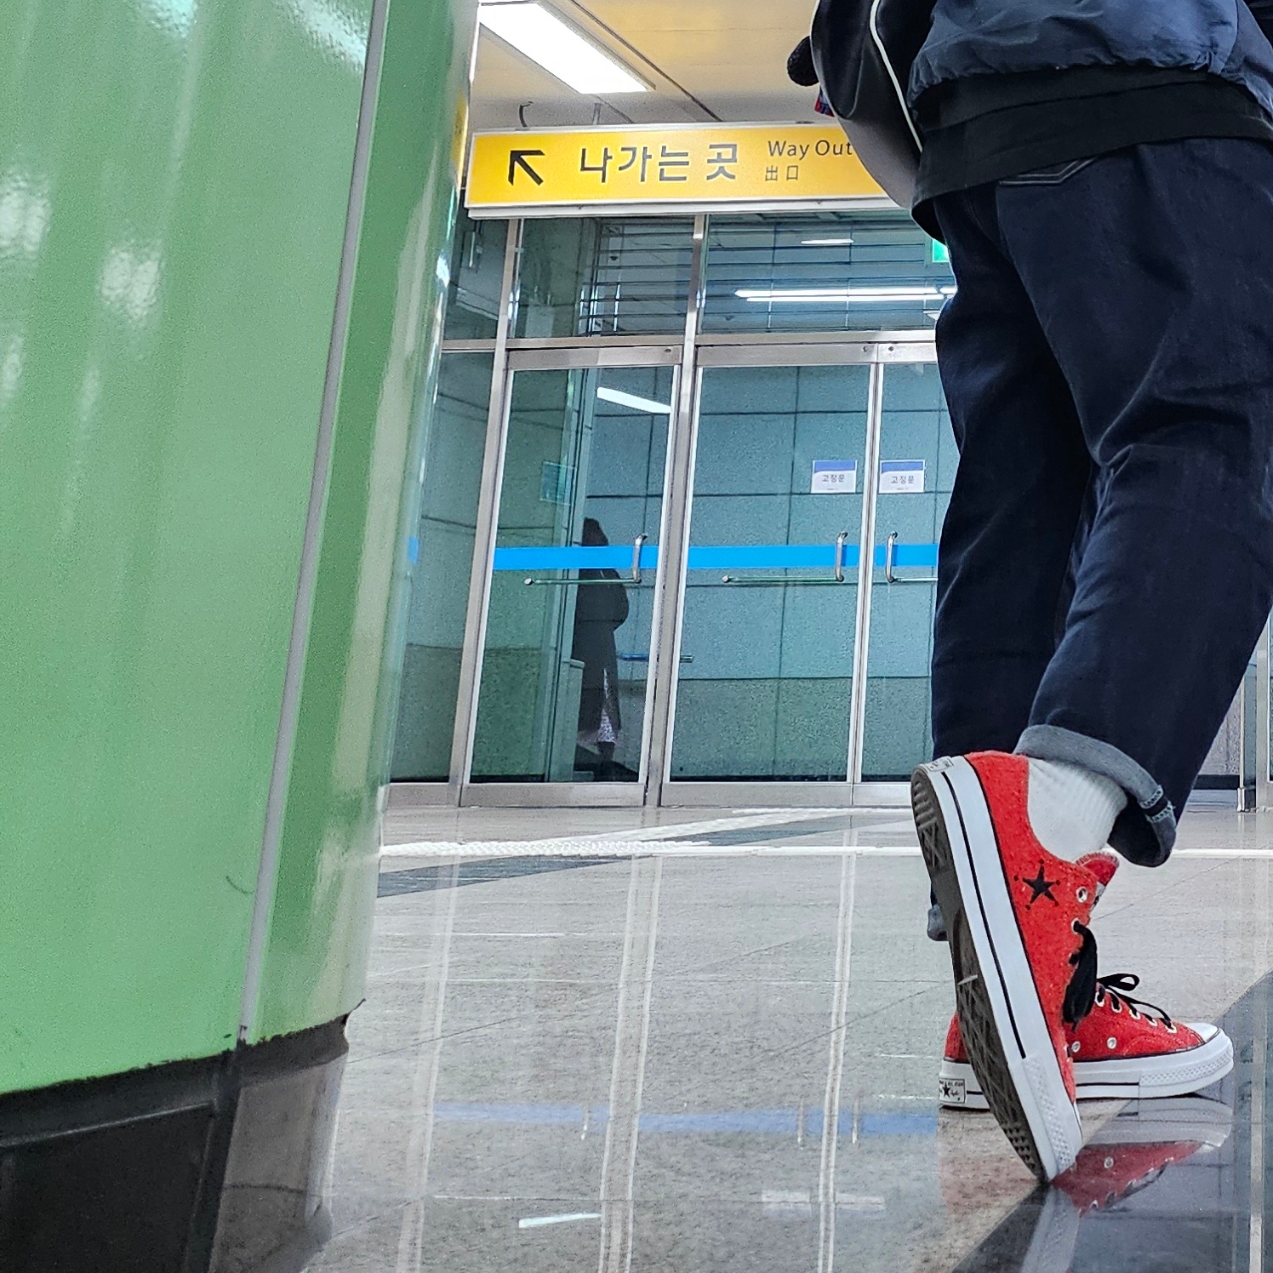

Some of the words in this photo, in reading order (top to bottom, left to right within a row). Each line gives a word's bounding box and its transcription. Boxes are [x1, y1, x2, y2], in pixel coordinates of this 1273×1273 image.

[768, 140, 810, 161] Way
[815, 139, 852, 157] Out
[579, 145, 690, 183] 나가는
[706, 143, 737, 181] 곳
[765, 165, 799, 182] 出口
